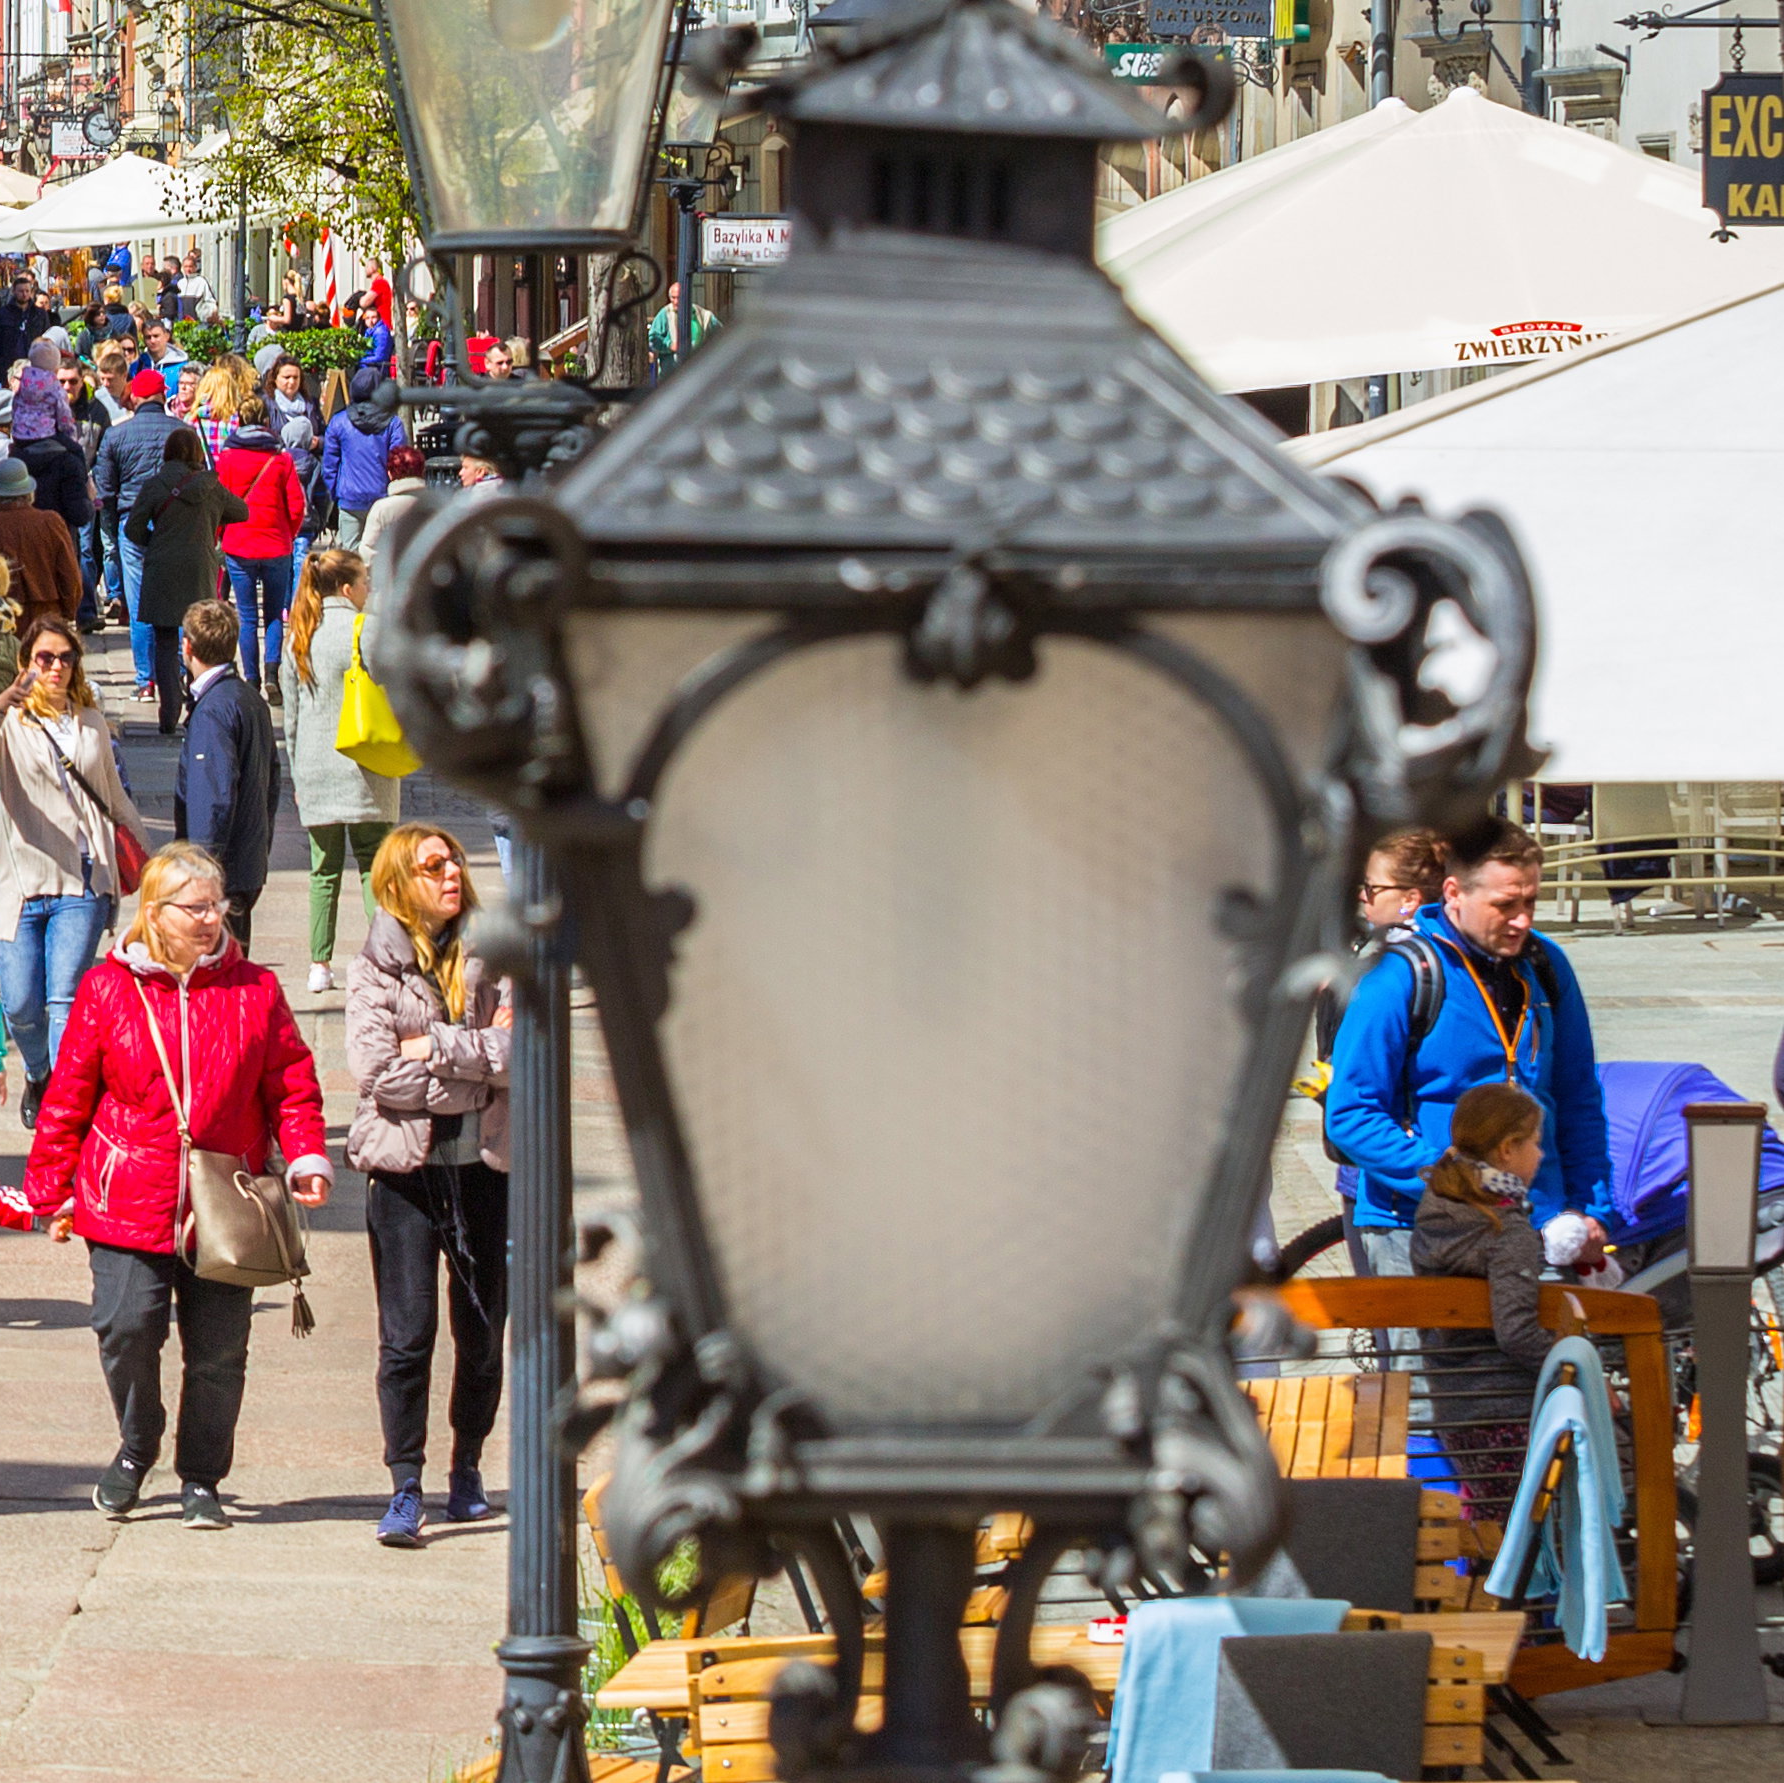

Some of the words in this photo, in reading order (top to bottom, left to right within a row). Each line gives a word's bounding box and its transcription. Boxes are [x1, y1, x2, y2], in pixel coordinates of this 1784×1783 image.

[1155, 8, 1266, 24] RATUSZOWA
[1111, 52, 1167, 77] SUB
[1728, 183, 1784, 217] KA
[714, 228, 762, 246] Bazylika
[1500, 323, 1572, 334] BROWAR
[1454, 332, 1609, 361] ZWIERZYN
